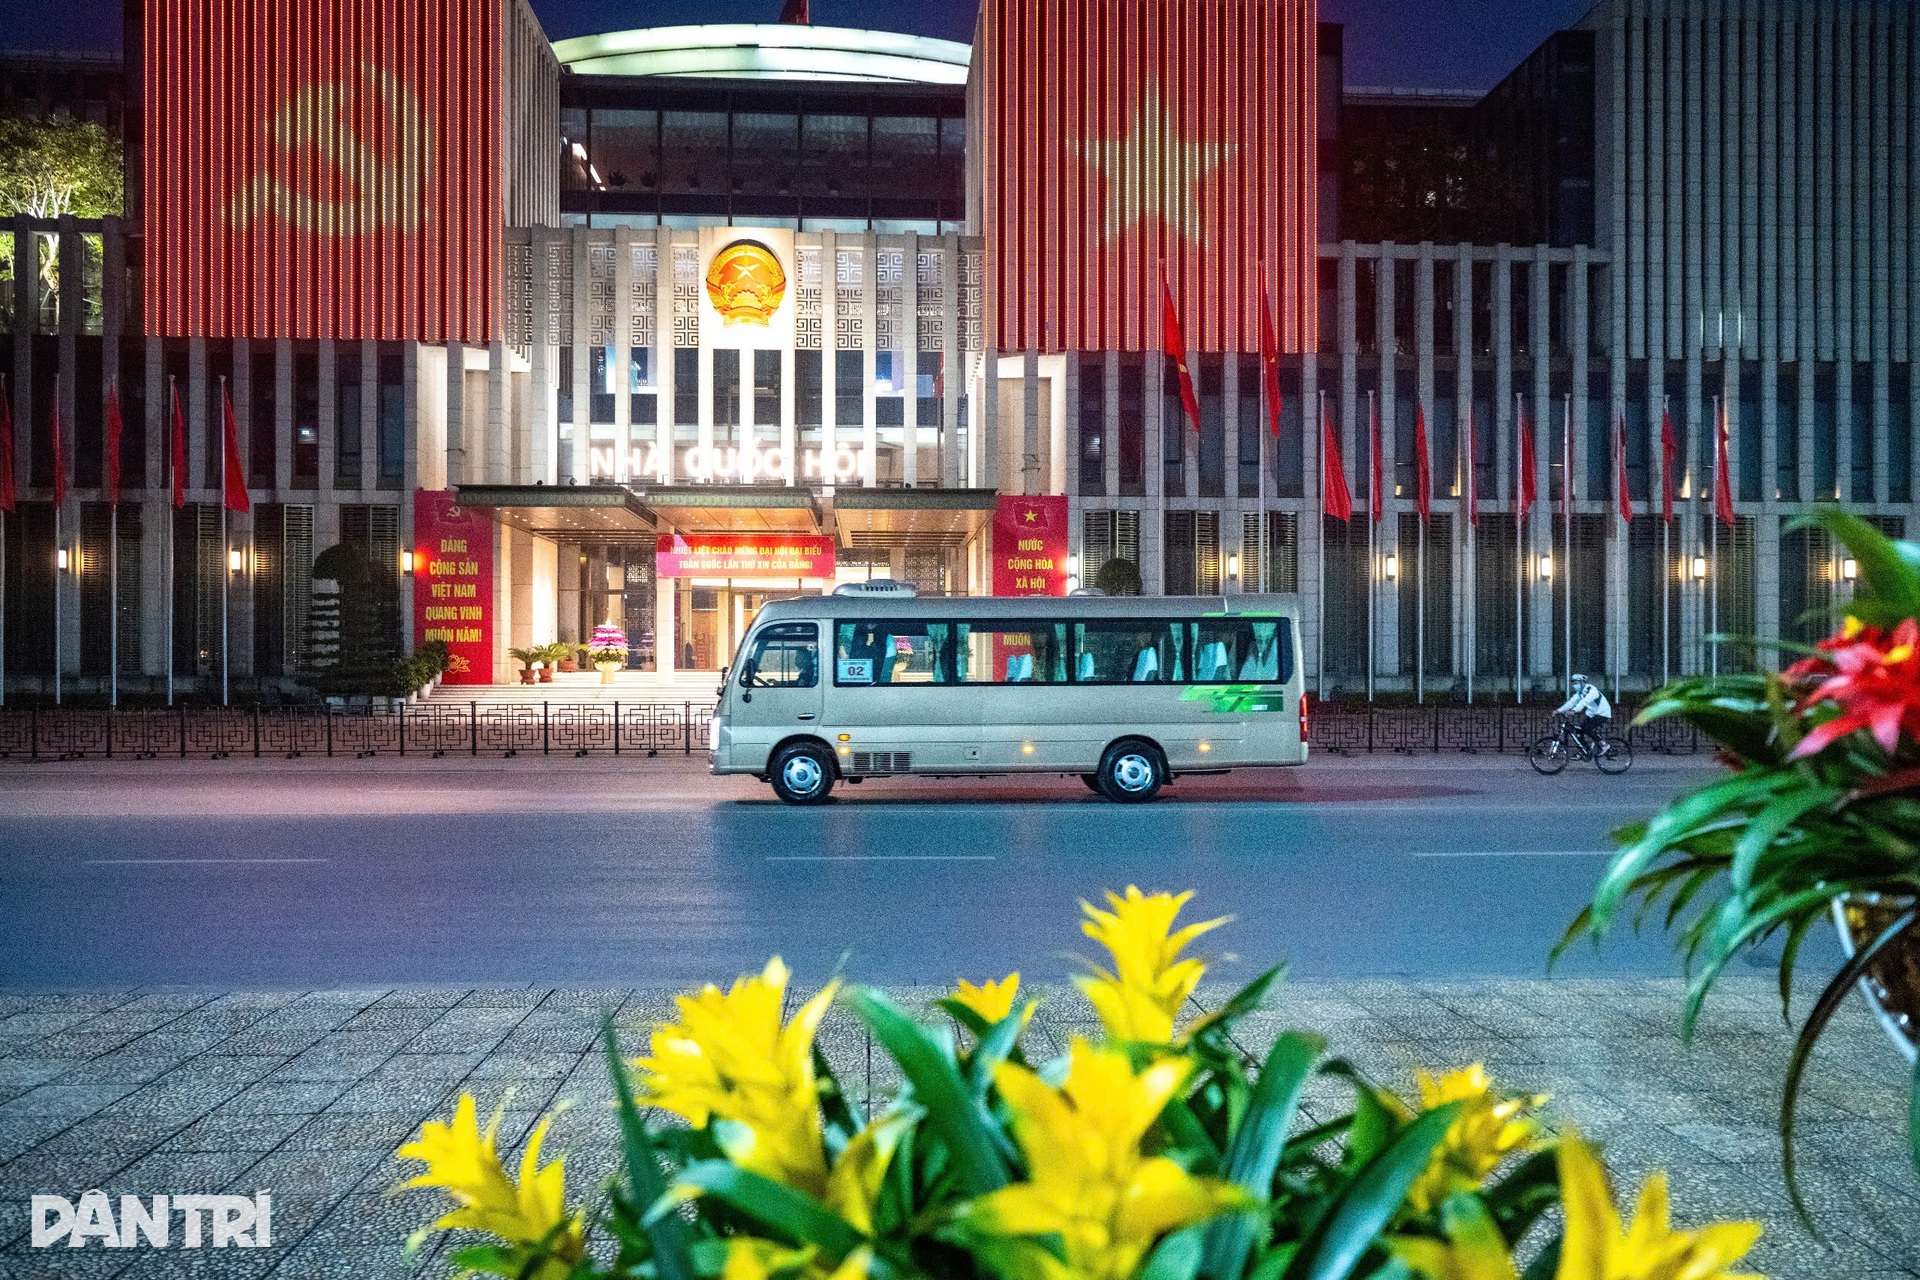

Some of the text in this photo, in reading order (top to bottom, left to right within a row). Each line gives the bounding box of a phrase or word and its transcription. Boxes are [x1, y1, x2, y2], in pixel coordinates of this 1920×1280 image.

[590, 436, 868, 482] NHÀ QUỐC HỘI
[441, 534, 467, 553] ĐẢNG
[1018, 538, 1043, 551] NƯỚC
[430, 557, 478, 578] CỘNG SẢN
[1007, 556, 1053, 571] CỘNG HÒA
[431, 581, 476, 600] VIỆT NAM
[1015, 576, 1046, 591] XÃ HỘI
[425, 606, 482, 621] QUANG VINH
[425, 626, 482, 642] MUÔN NĂM!
[847, 666, 864, 676] 02
